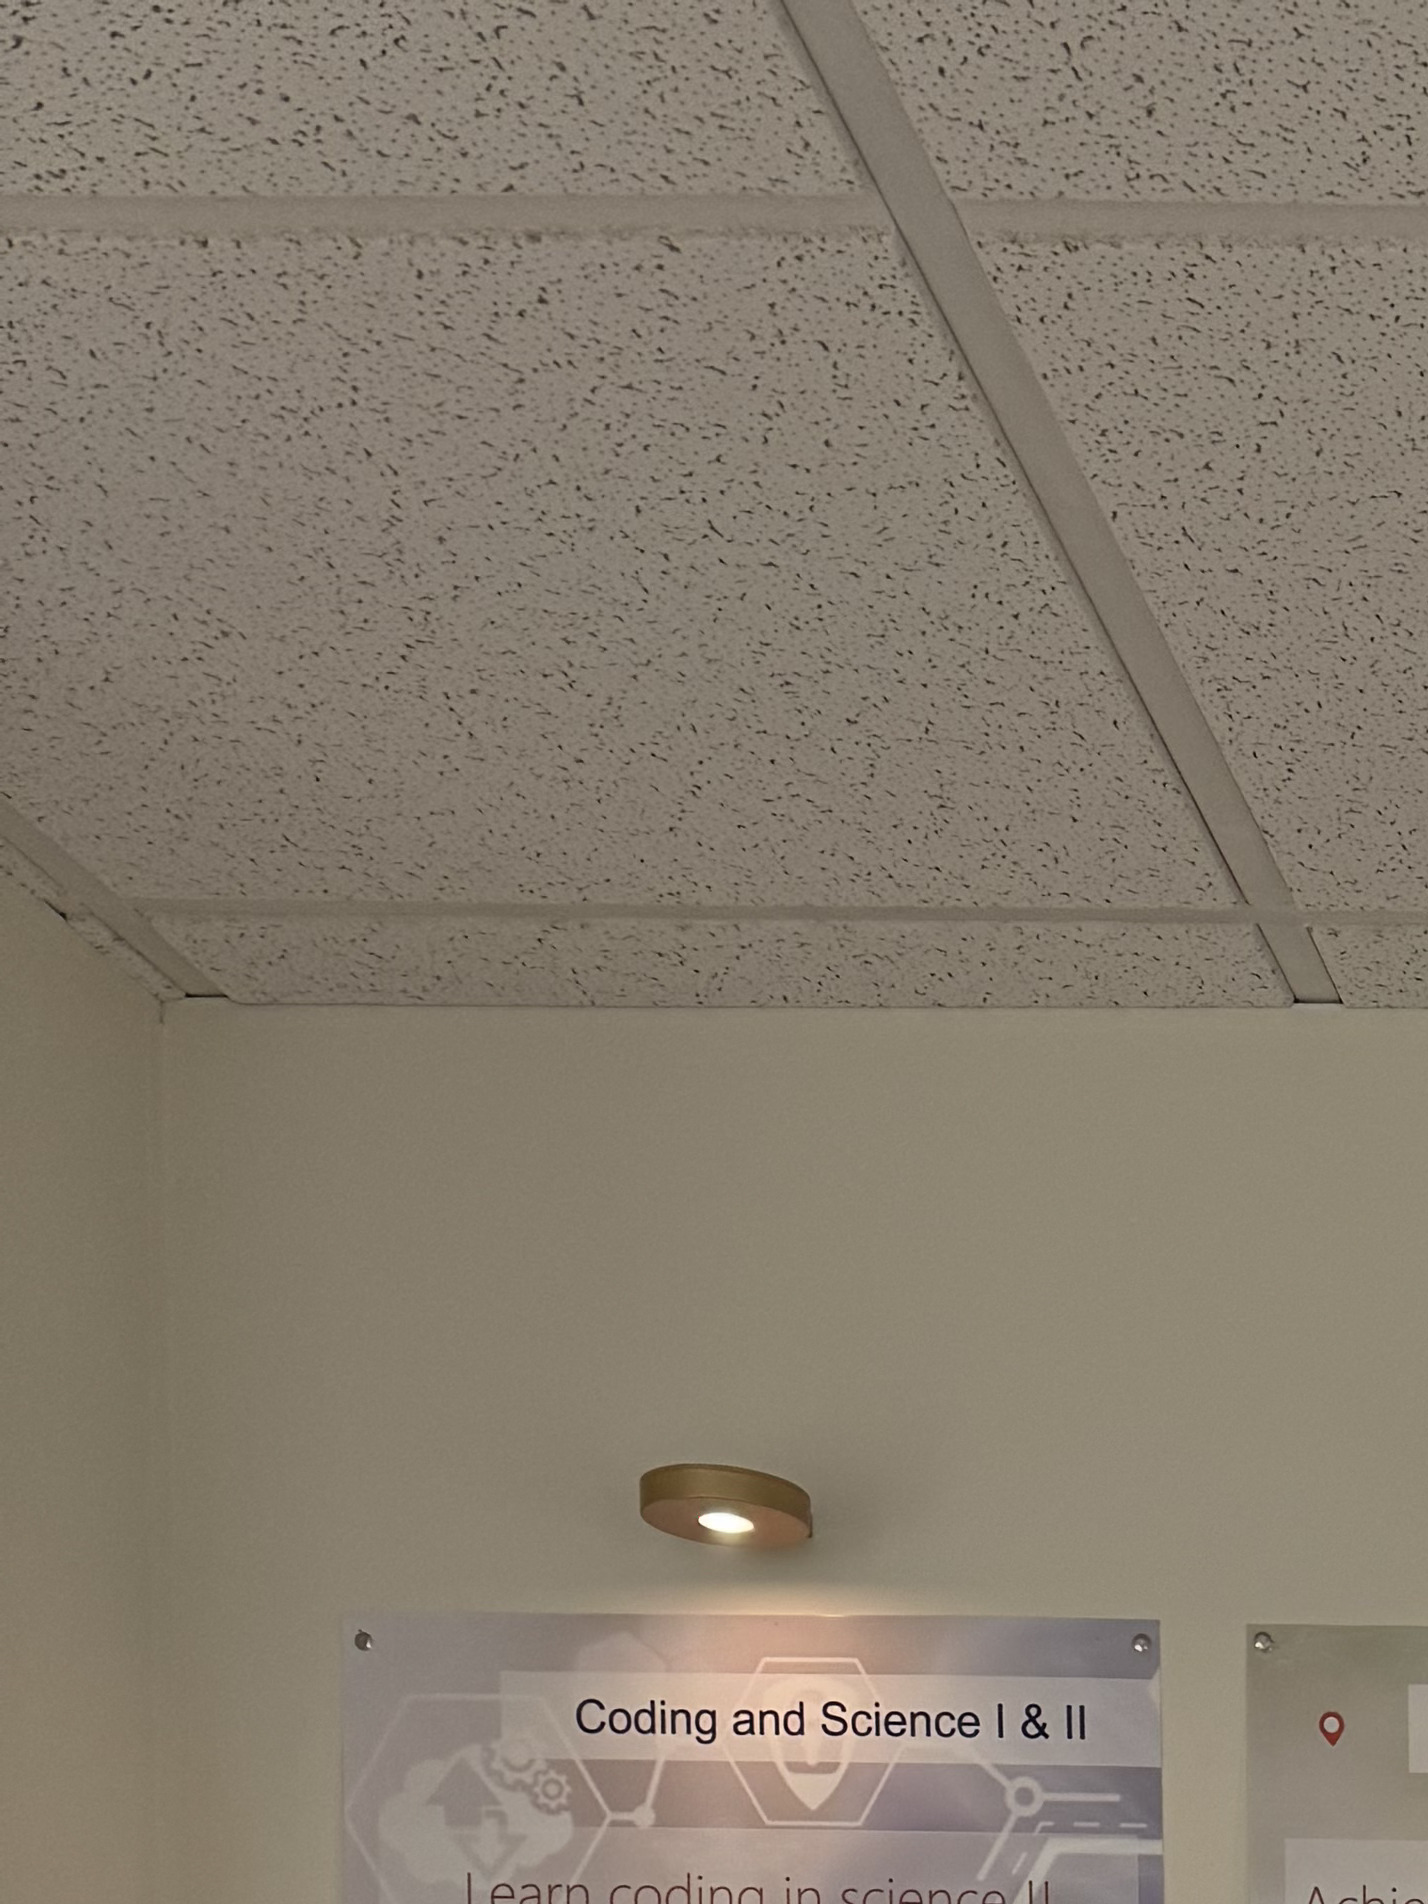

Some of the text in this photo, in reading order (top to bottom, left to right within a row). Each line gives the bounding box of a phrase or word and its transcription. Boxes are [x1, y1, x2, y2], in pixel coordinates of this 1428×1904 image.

[576, 1698, 1086, 1745] Coding and Science I & II
